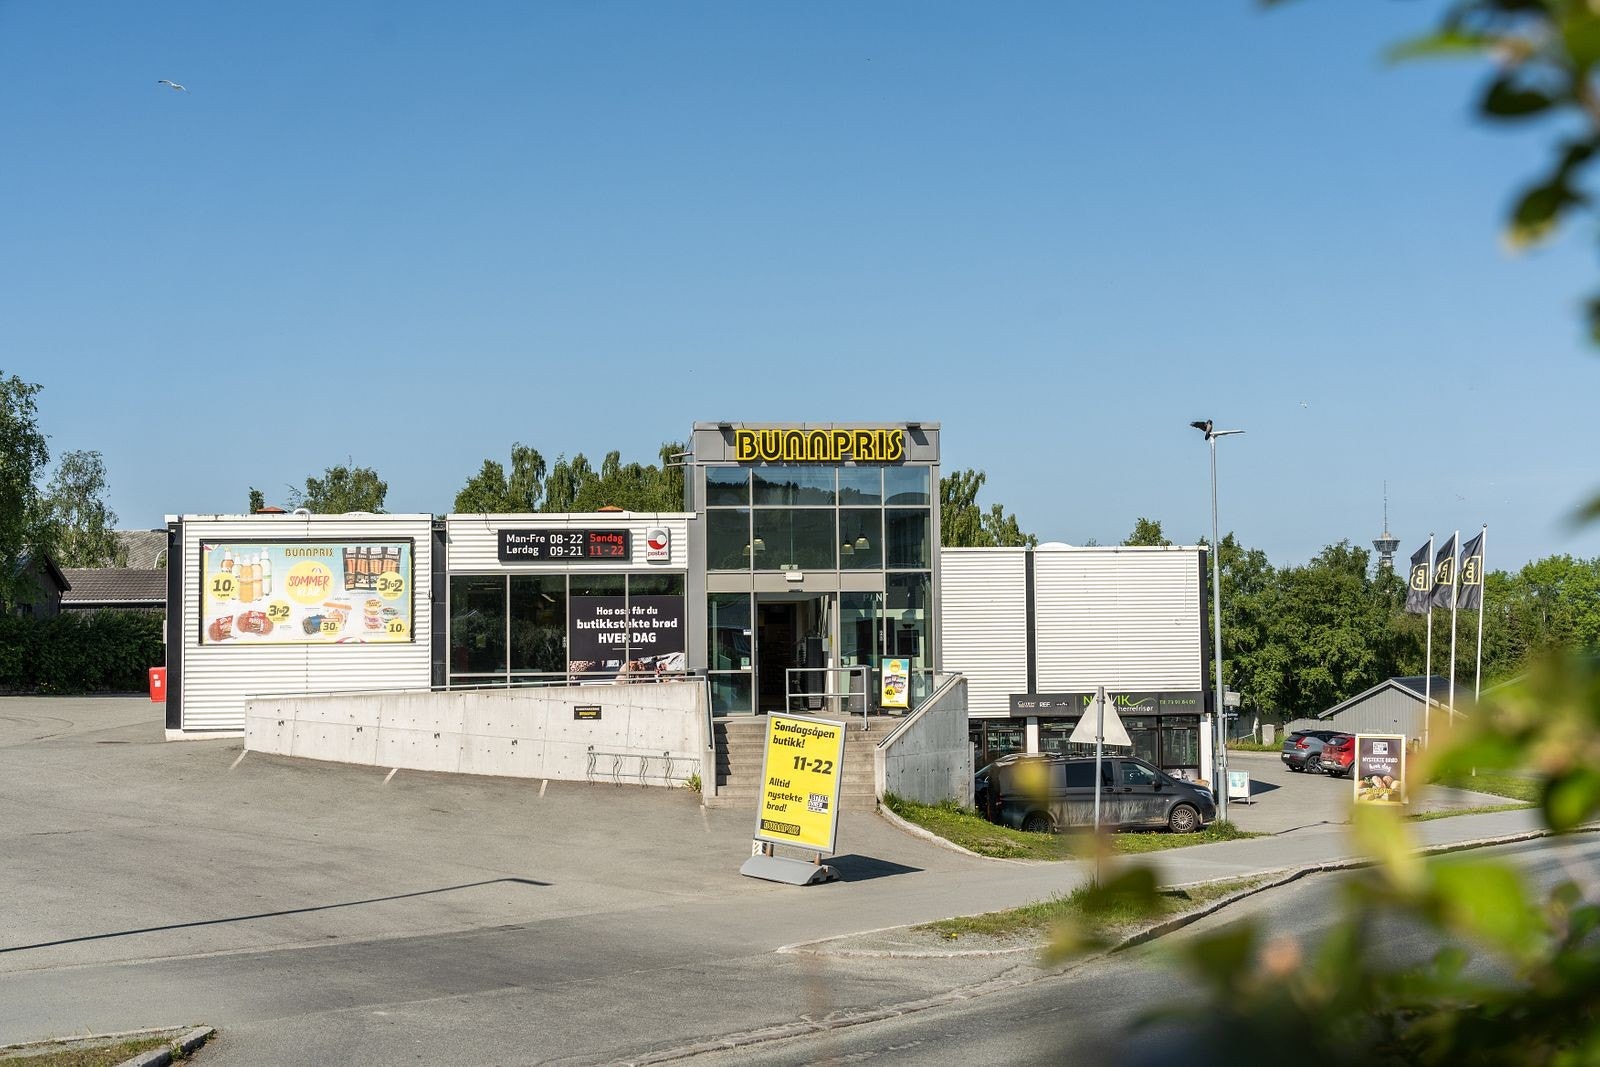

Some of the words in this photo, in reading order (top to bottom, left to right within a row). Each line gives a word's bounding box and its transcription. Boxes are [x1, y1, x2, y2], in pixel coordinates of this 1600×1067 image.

[735, 429, 903, 461] BUNNPRIS
[506, 534, 546, 543] Man-Fre
[590, 533, 623, 544] Søndag
[285, 548, 334, 557] BUNNPRIS
[506, 546, 539, 556] Lørdag
[289, 575, 330, 591] SOMMER
[596, 607, 613, 615] Hos
[632, 606, 646, 615] får
[647, 606, 658, 615] du
[576, 618, 650, 629] butikkstekte
[652, 618, 678, 628] brød
[598, 633, 631, 644] HVER
[632, 632, 657, 643] DAG
[774, 720, 835, 739] Søndagsåpen
[772, 735, 806, 749] butikk!
[793, 755, 833, 775] 11-22
[769, 777, 791, 788] Alltid
[767, 791, 803, 803] nystekte
[766, 801, 788, 812] brød!
